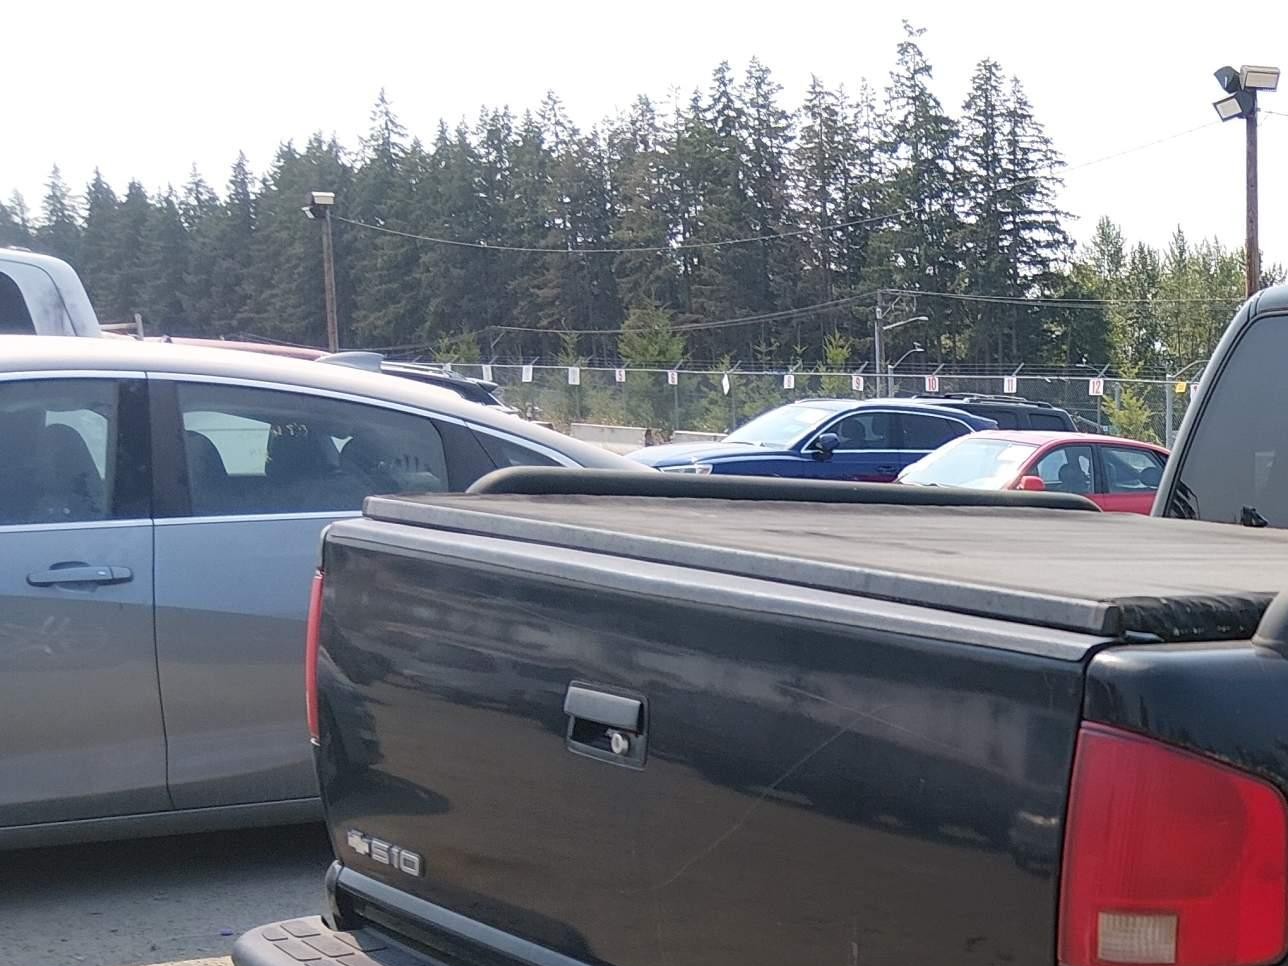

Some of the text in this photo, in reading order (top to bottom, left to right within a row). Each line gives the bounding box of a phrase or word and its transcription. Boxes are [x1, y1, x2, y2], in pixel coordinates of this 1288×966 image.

[928, 377, 937, 391] 10
[1092, 380, 1101, 394] 12
[371, 838, 420, 877] S10
